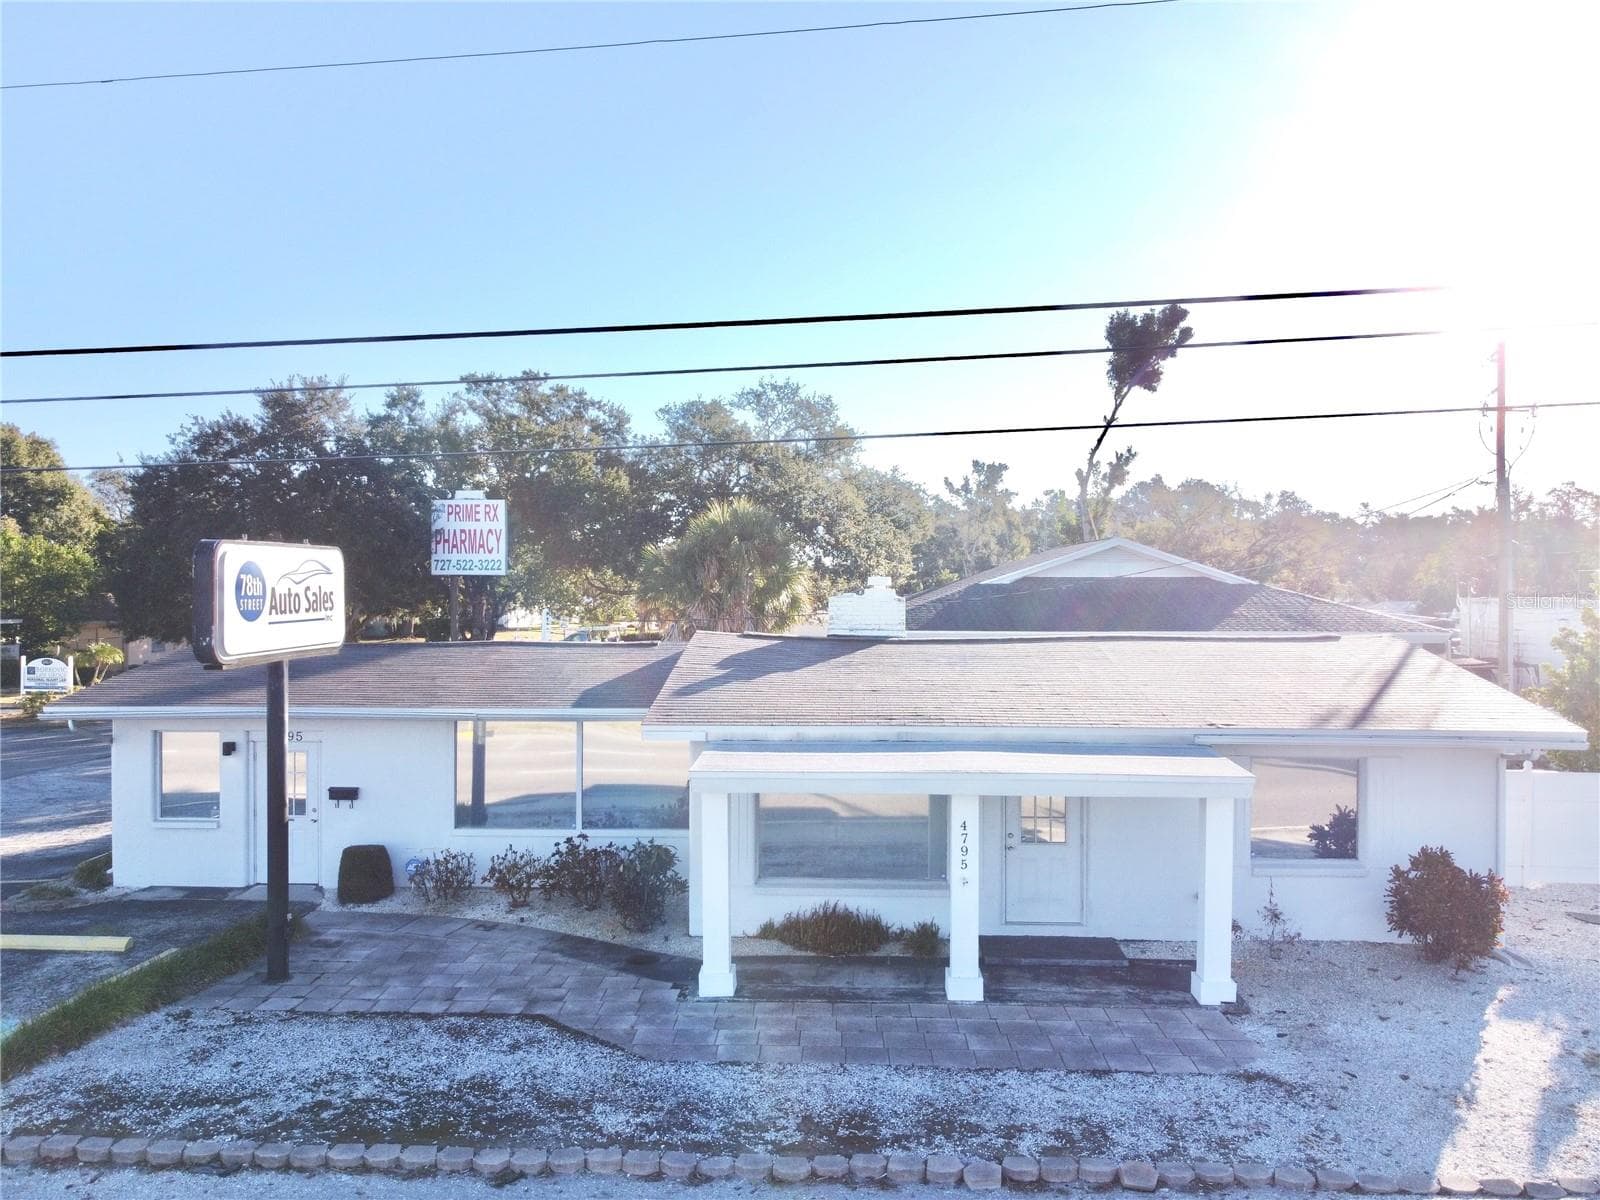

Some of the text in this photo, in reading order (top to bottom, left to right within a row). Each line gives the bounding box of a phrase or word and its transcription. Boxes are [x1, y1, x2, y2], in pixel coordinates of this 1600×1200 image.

[447, 503, 499, 522] PRIME RX
[434, 528, 503, 554] PHARMACY
[433, 559, 502, 571] 727-522-3222
[240, 574, 263, 596] 78th
[240, 598, 263, 611] STREET
[268, 585, 334, 615] Auto Sales
[960, 820, 968, 870] 4795
